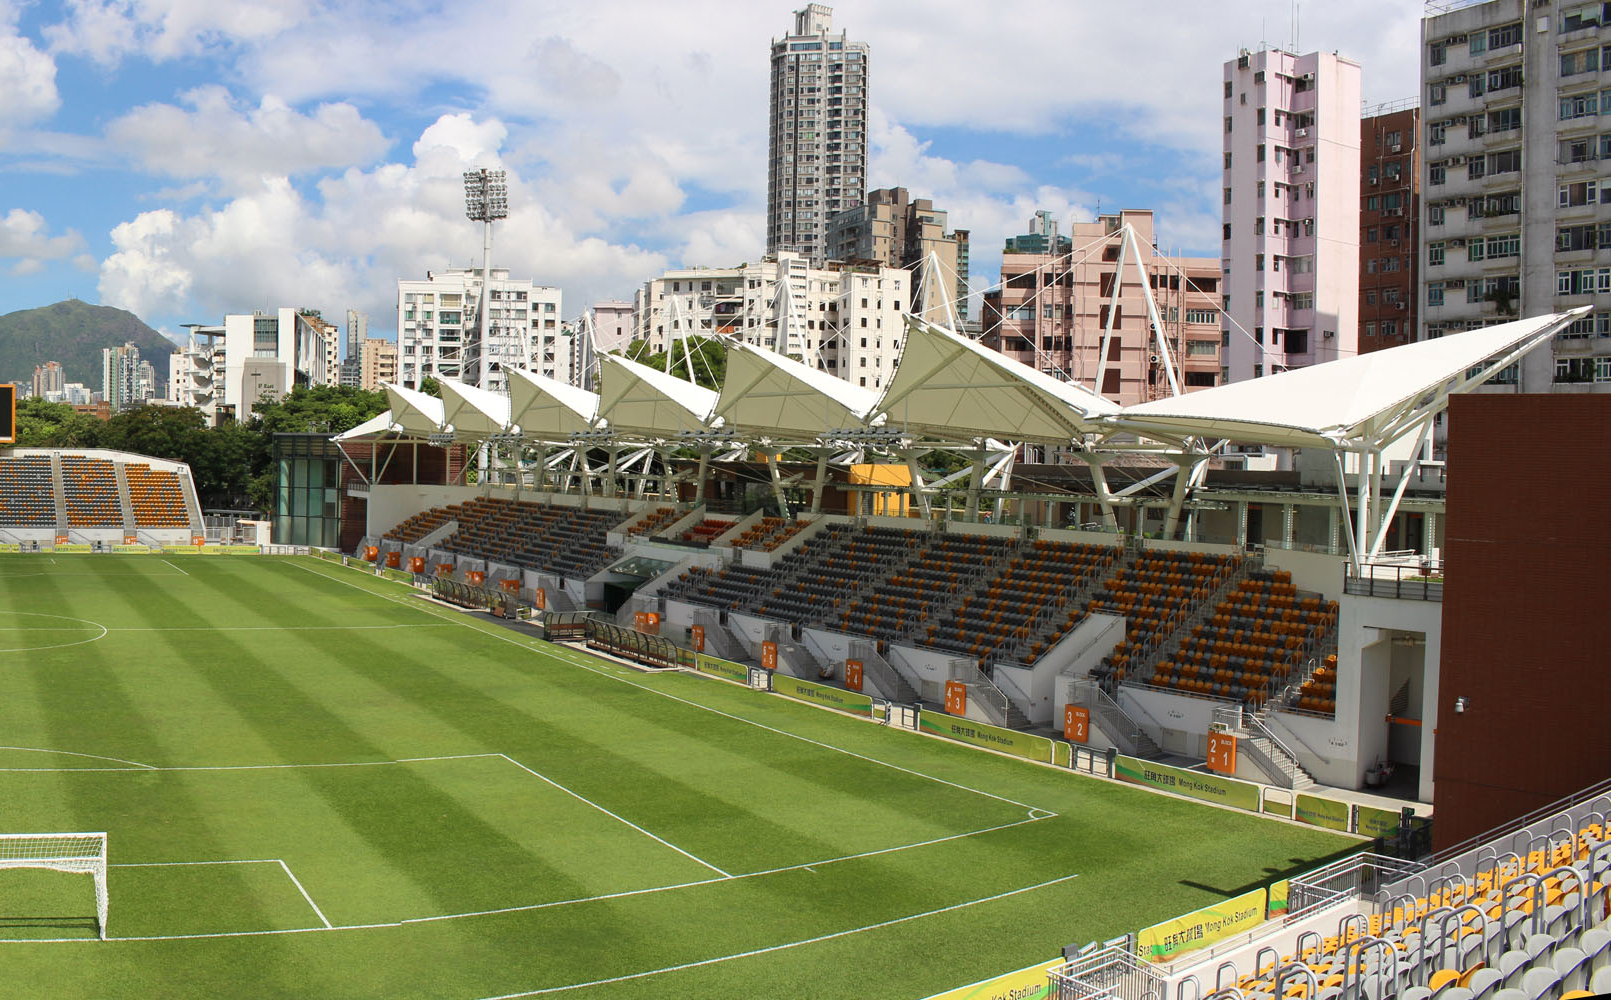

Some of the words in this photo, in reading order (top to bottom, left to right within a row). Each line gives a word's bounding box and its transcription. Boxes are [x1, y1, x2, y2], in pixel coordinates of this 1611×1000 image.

[769, 655, 773, 665] 5
[847, 665, 851, 675] 5
[853, 674, 858, 685] 4
[947, 687, 952, 698] 4
[955, 697, 960, 709] 3
[1067, 711, 1072, 724] 3
[1077, 722, 1082, 736] 2
[1210, 739, 1216, 753] 2
[1222, 752, 1228, 766] 1
[1144, 770, 1175, 786] 旺角大球場
[1178, 778, 1192, 790] Mong
[1194, 782, 1203, 790] Kok
[1009, 984, 1041, 1000] Stadium
